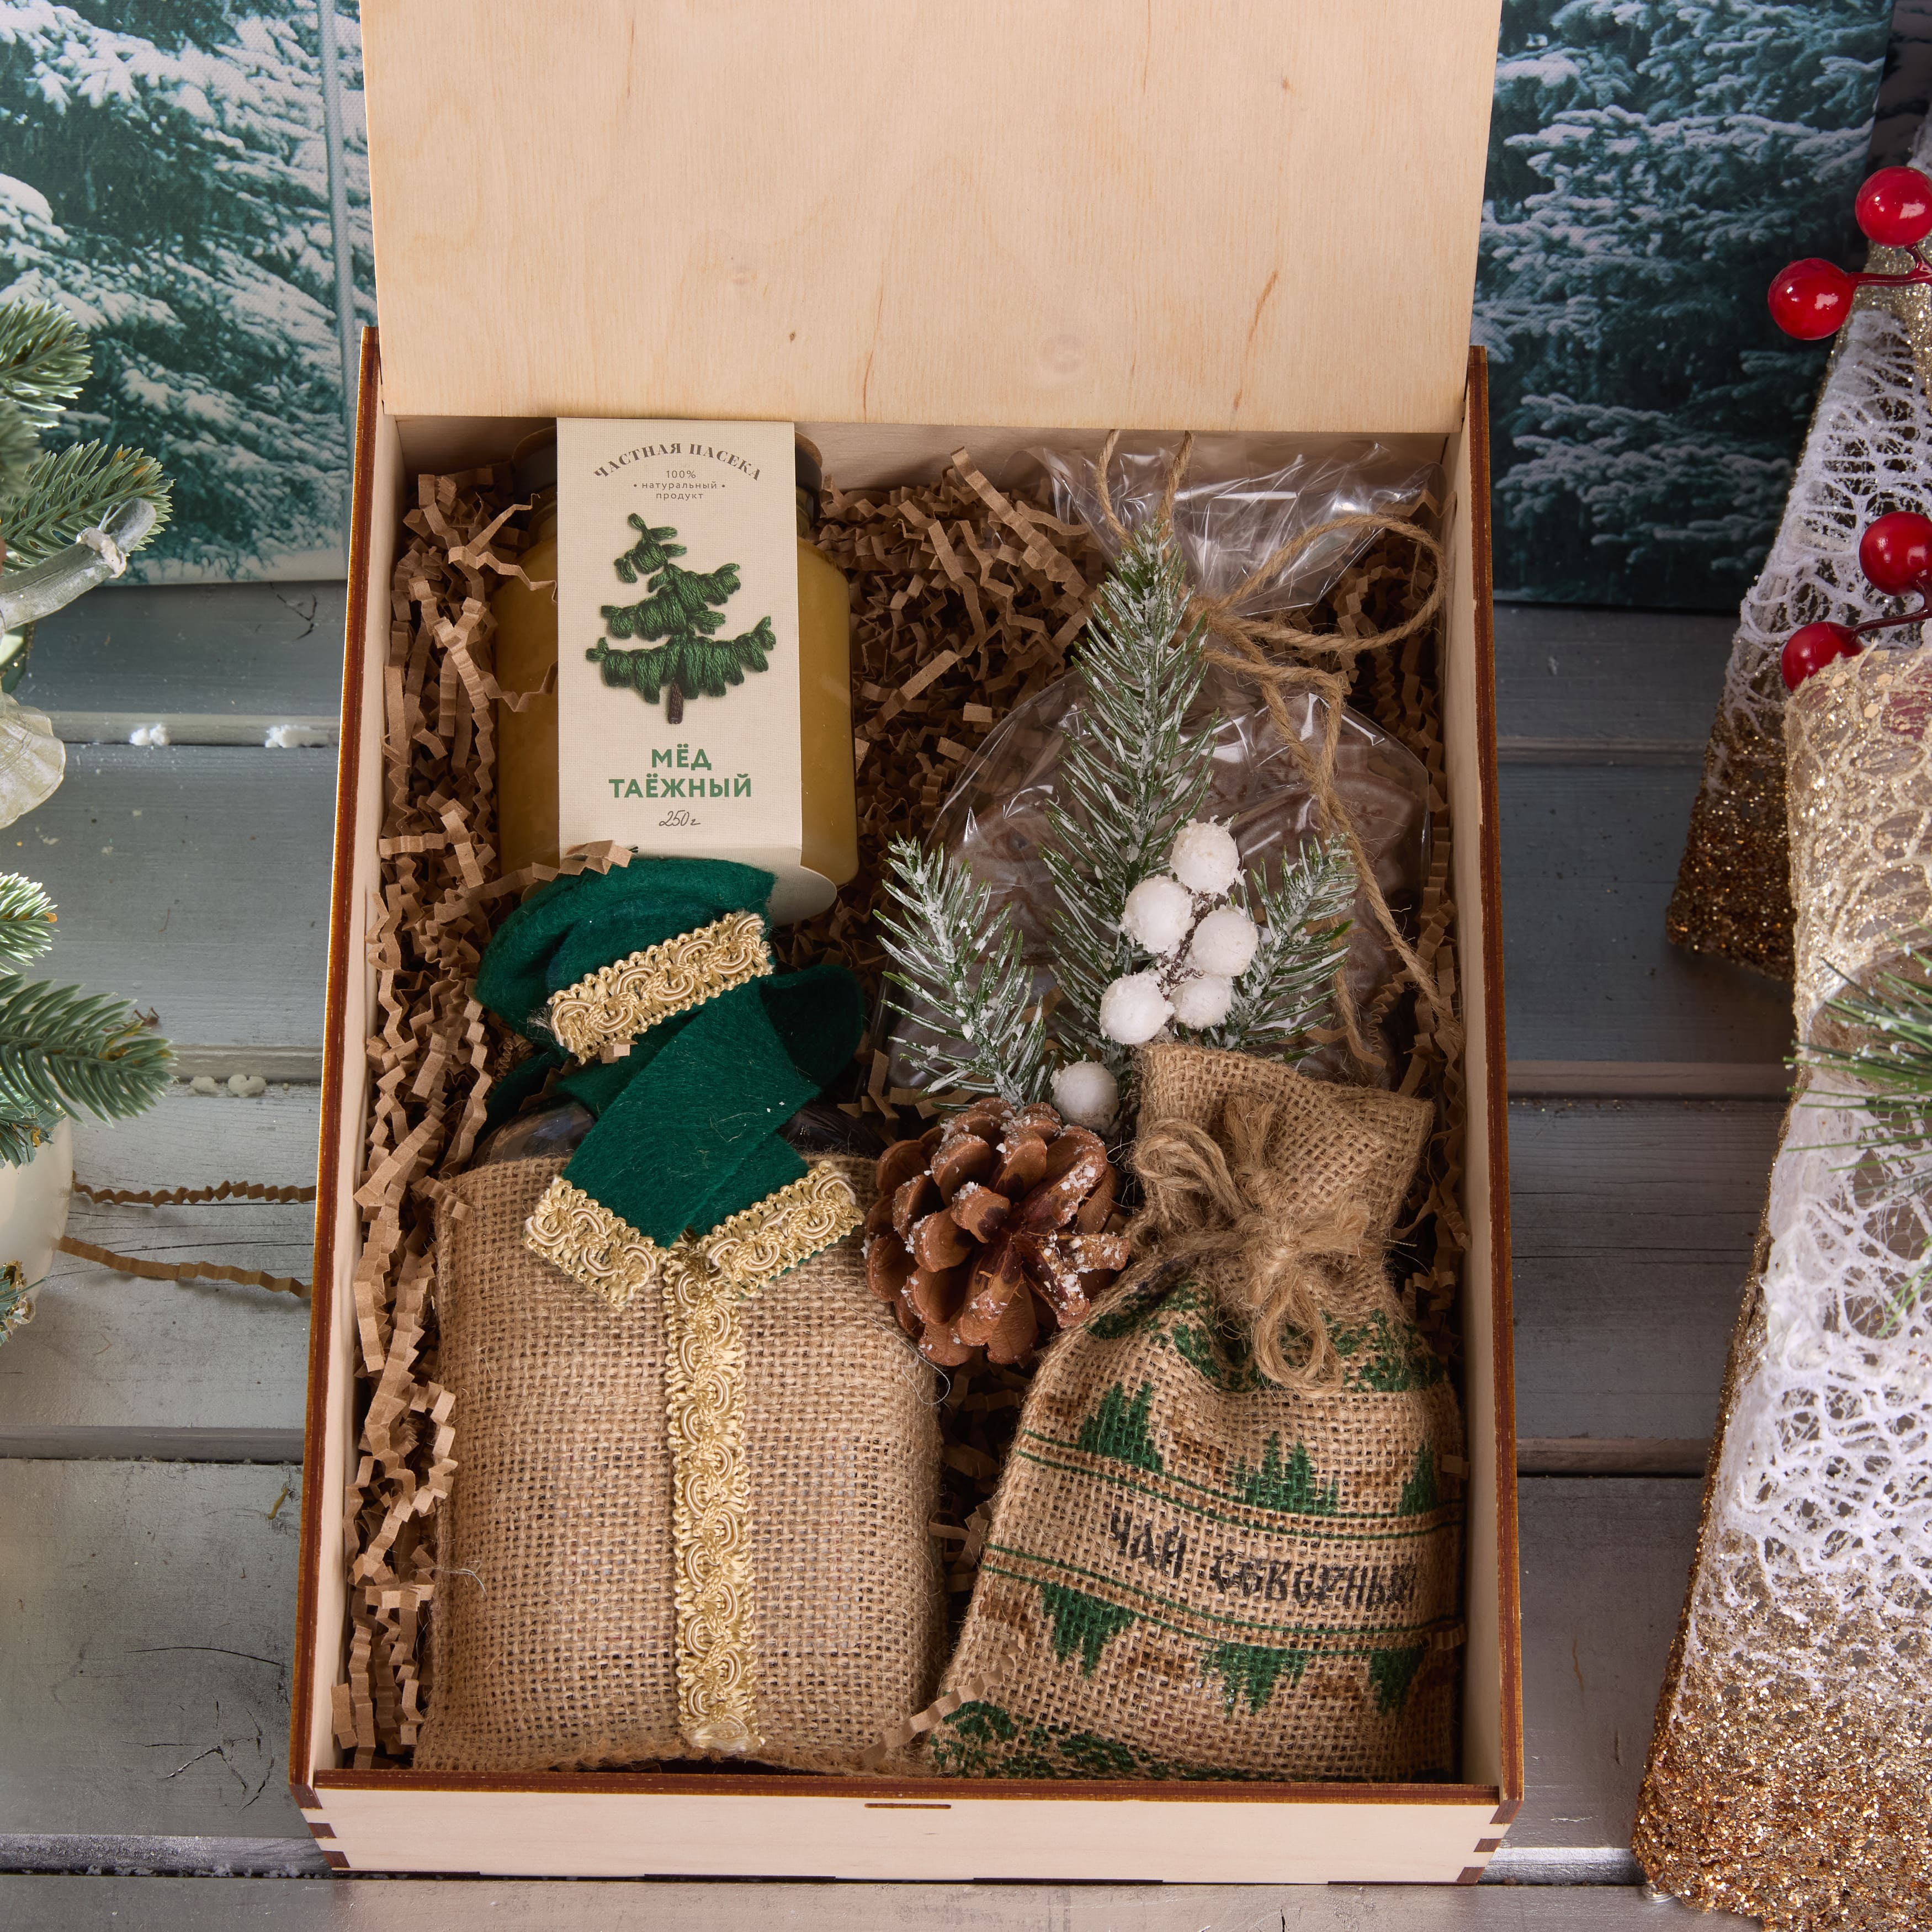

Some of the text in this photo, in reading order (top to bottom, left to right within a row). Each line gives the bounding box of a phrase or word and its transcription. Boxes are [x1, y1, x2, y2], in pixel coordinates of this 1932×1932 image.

[593, 443, 761, 481] ЧАСТНАЯ ПАСЕКА
[666, 470, 697, 479] 100%
[641, 481, 718, 491] натуральный
[656, 492, 704, 501] продукт
[651, 743, 712, 771] МЁД
[608, 773, 751, 798] ТАЁЖНЫЙ
